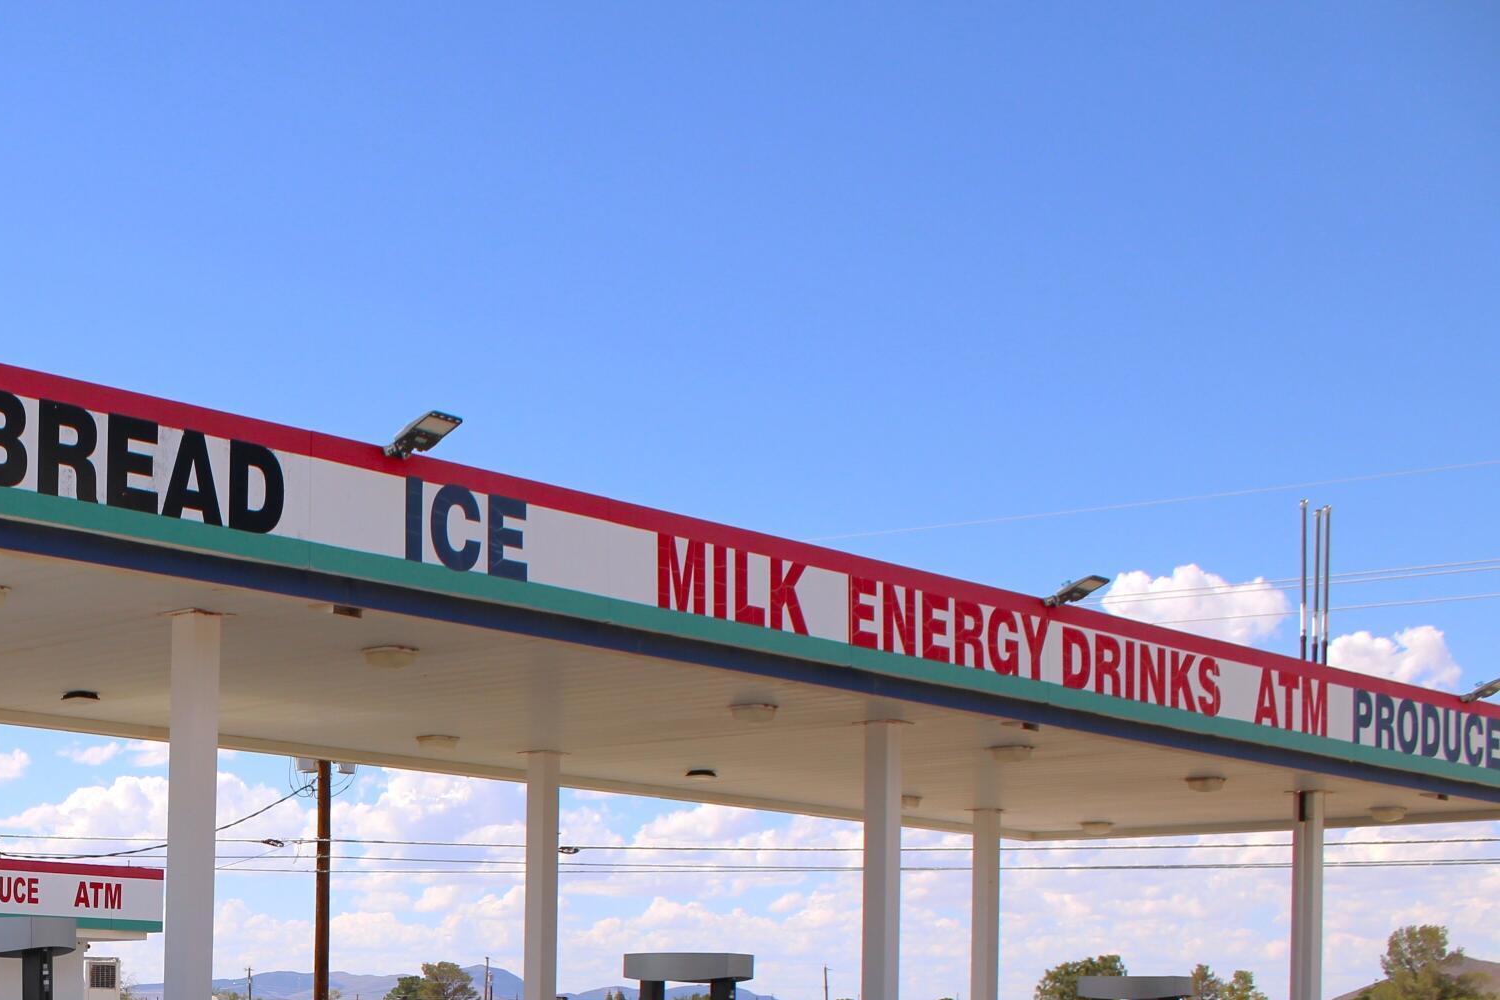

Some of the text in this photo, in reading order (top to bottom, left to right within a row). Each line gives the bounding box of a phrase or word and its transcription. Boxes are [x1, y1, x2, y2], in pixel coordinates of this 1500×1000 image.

[405, 476, 527, 582] ICE
[657, 533, 809, 637] MILK
[849, 574, 1050, 679] ENERGY
[1062, 620, 1221, 718] DRINKS
[1253, 668, 1328, 738] ATM
[1352, 686, 1500, 770] PRODUCE
[74, 881, 122, 909] ATM
